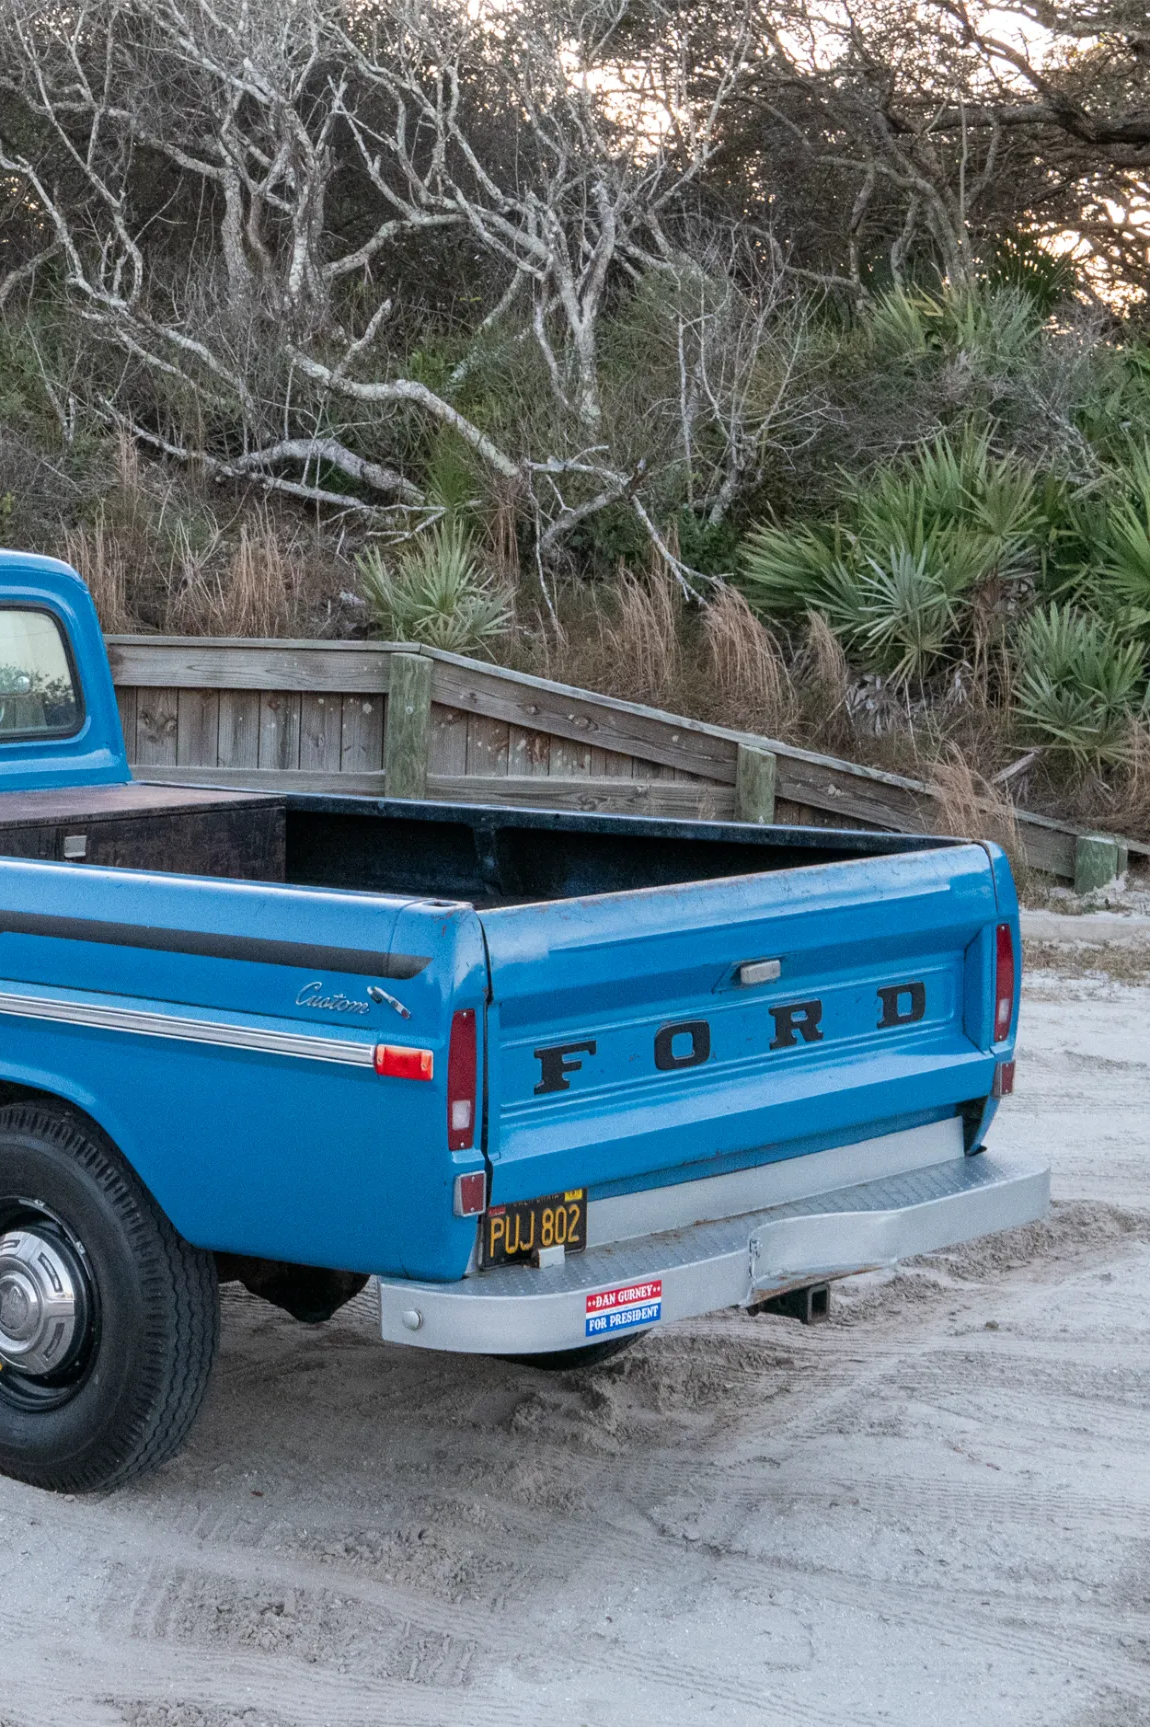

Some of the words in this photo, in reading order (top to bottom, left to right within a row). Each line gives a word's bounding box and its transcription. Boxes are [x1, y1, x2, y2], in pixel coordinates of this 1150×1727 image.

[296, 981, 370, 1014] Custom
[533, 980, 926, 1095] FORD
[490, 1211, 535, 1258] PUJ
[541, 1203, 581, 1246] 802
[595, 1292, 616, 1308] DAN
[617, 1284, 653, 1303] GURNEY
[589, 1317, 607, 1332] FOR
[609, 1305, 659, 1327] PRESIDENT
